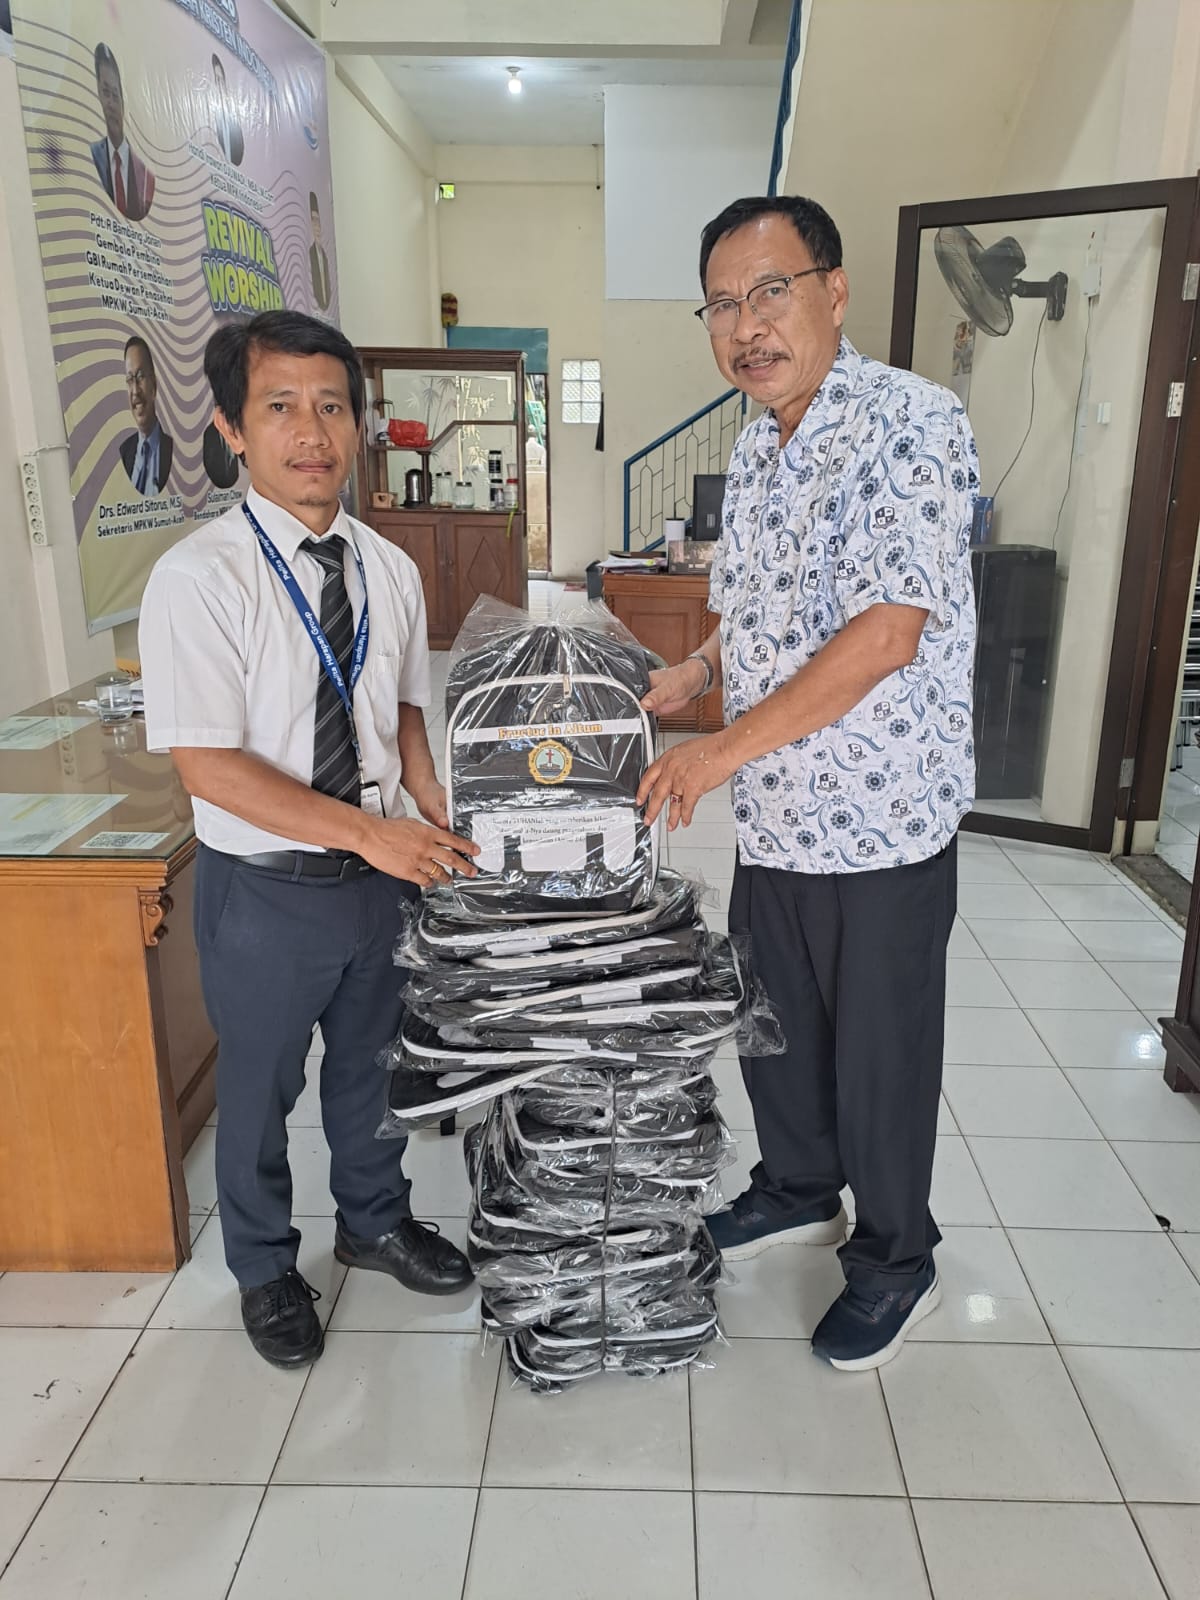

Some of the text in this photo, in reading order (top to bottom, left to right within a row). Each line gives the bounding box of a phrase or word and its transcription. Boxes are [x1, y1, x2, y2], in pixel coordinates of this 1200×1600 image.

[112, 221, 143, 244] Bambang
[202, 199, 277, 275] REVIVAL
[96, 233, 160, 266] Gembala Pembina
[86, 250, 173, 287] GBI Rumah Persembahan
[88, 271, 114, 290] Ketua
[114, 278, 140, 296] Dewan
[202, 257, 284, 313] WORSHIP
[99, 505, 115, 519] Drs.
[116, 502, 143, 516] Edward
[97, 522, 133, 537] Sekretaris
[304, 611, 344, 687] Pelita Harapan Group
[355, 634, 367, 663] Harapan
